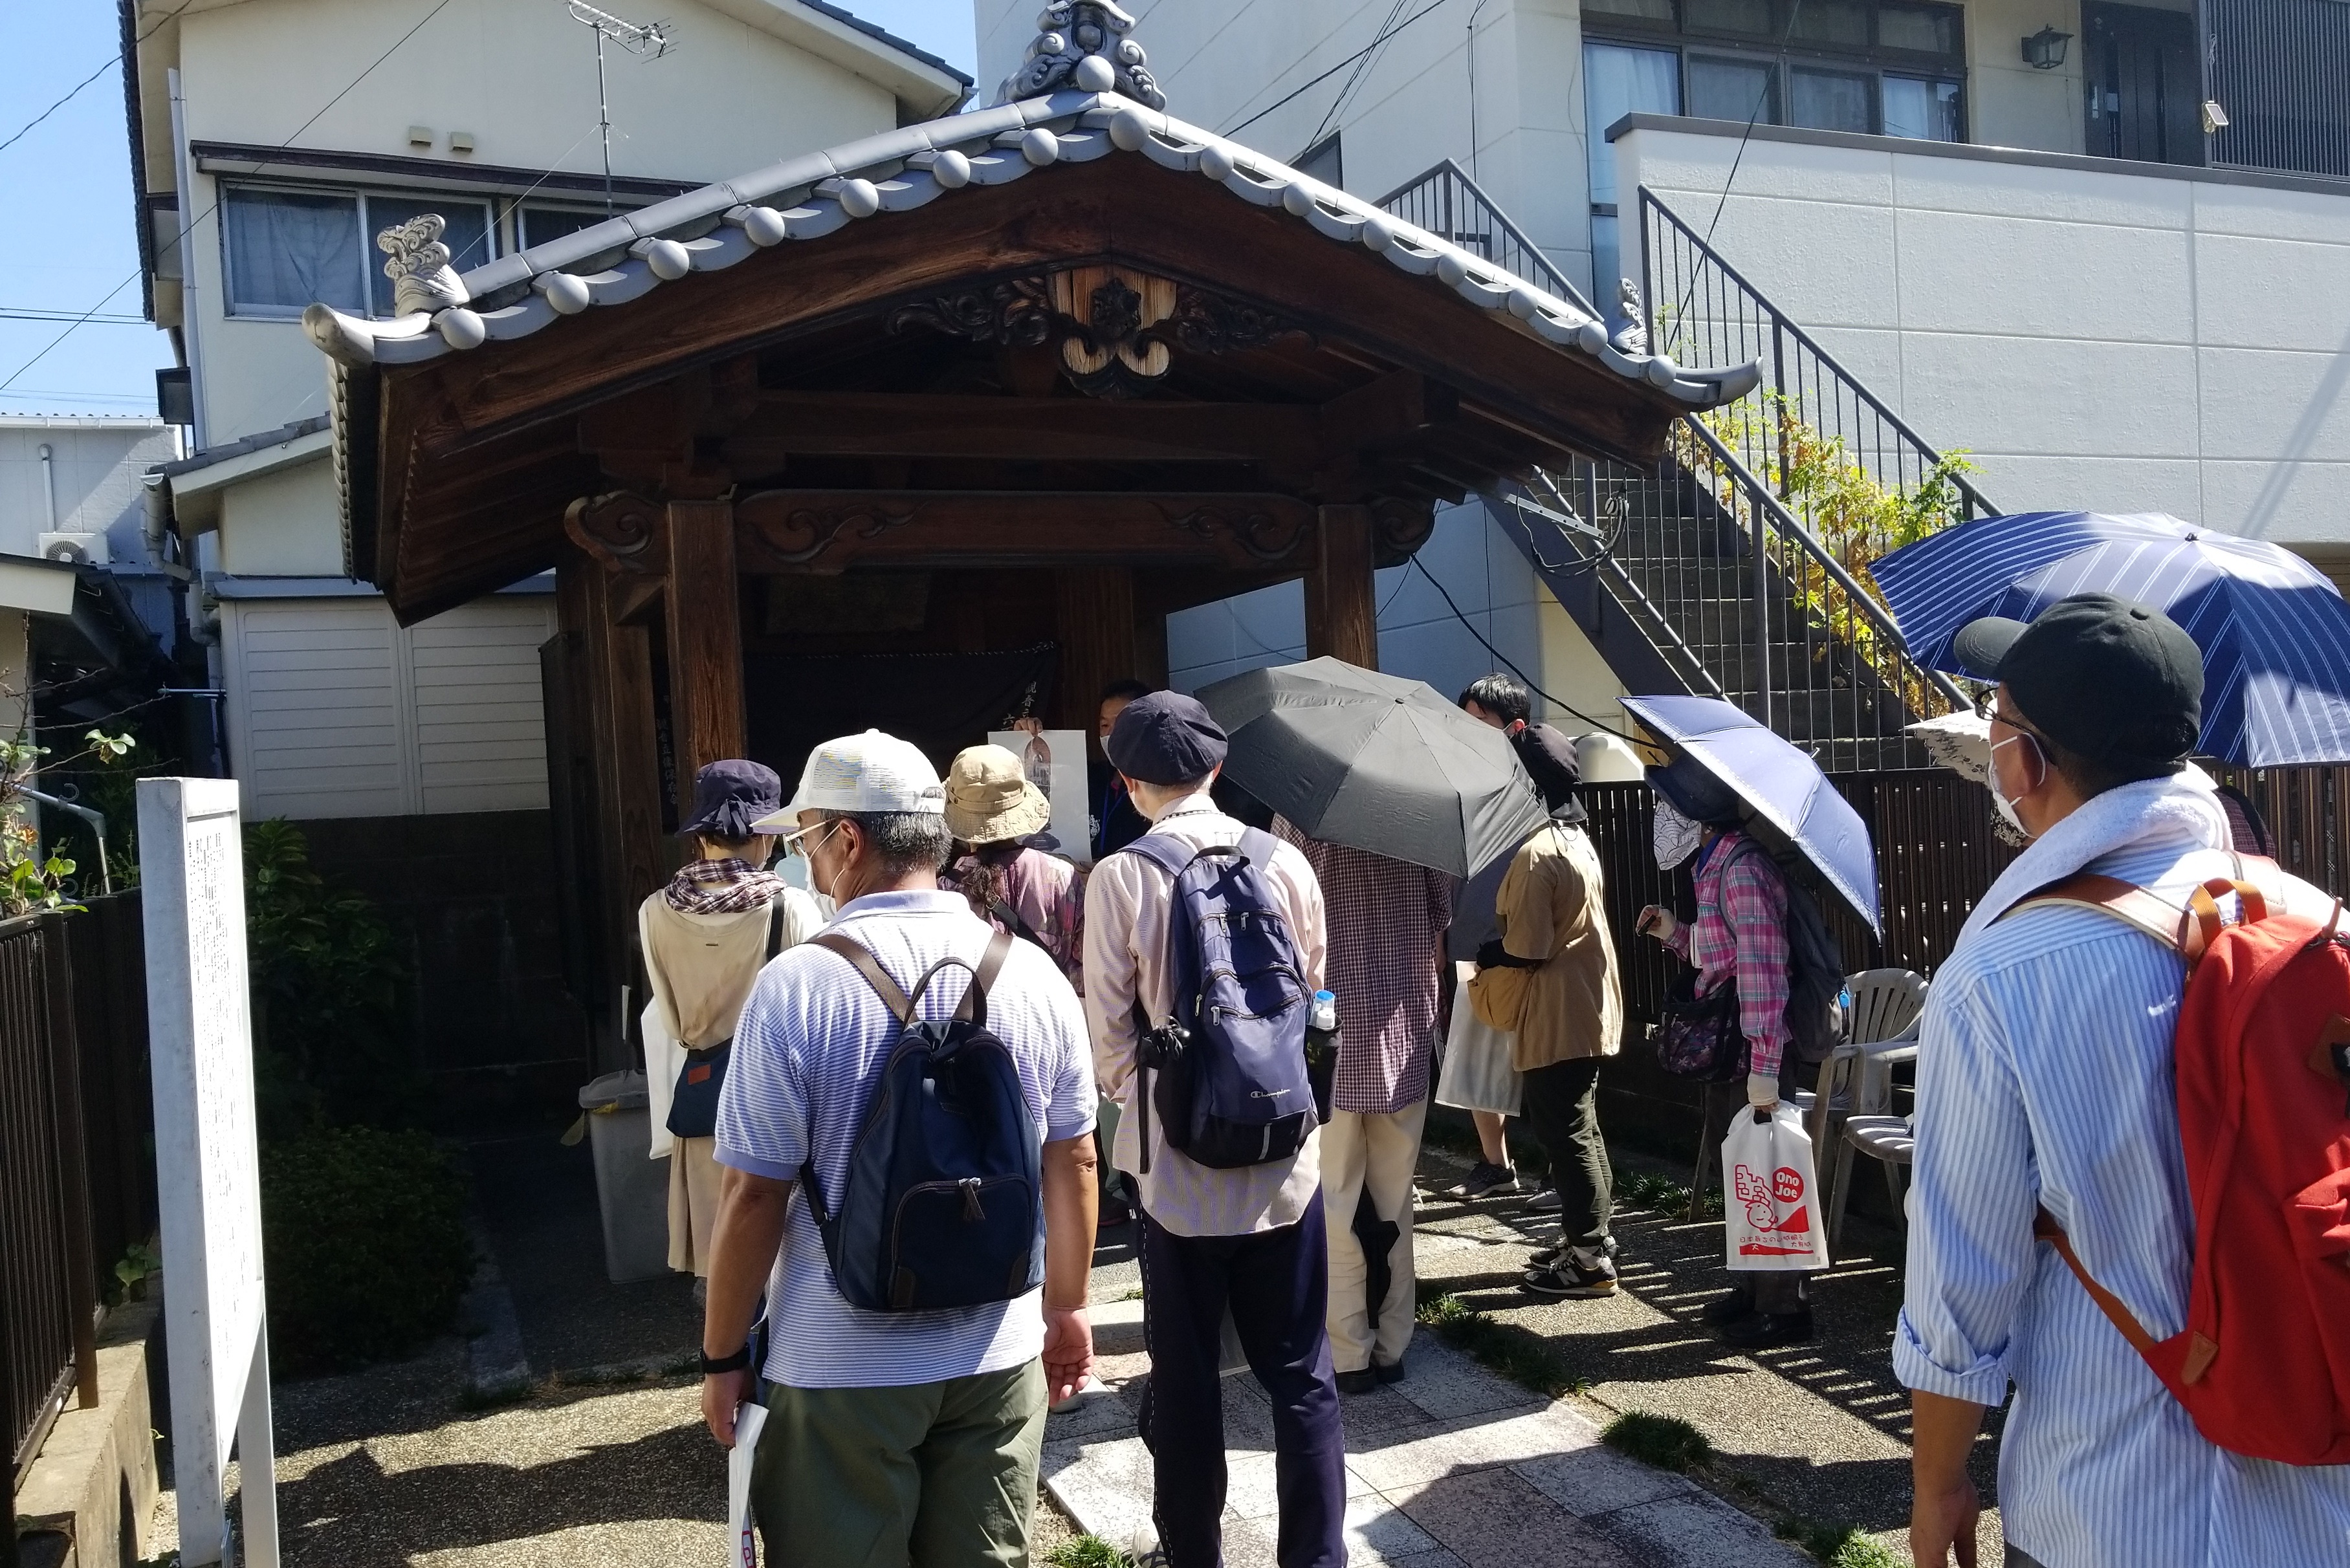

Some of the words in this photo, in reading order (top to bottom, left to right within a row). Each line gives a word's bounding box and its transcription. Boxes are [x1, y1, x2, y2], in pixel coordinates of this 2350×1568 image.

[1250, 1089, 1291, 1098] Champion
[1776, 1171, 1799, 1186] Ono
[1775, 1184, 1797, 1198] Joe
[1556, 1267, 1580, 1285] N
